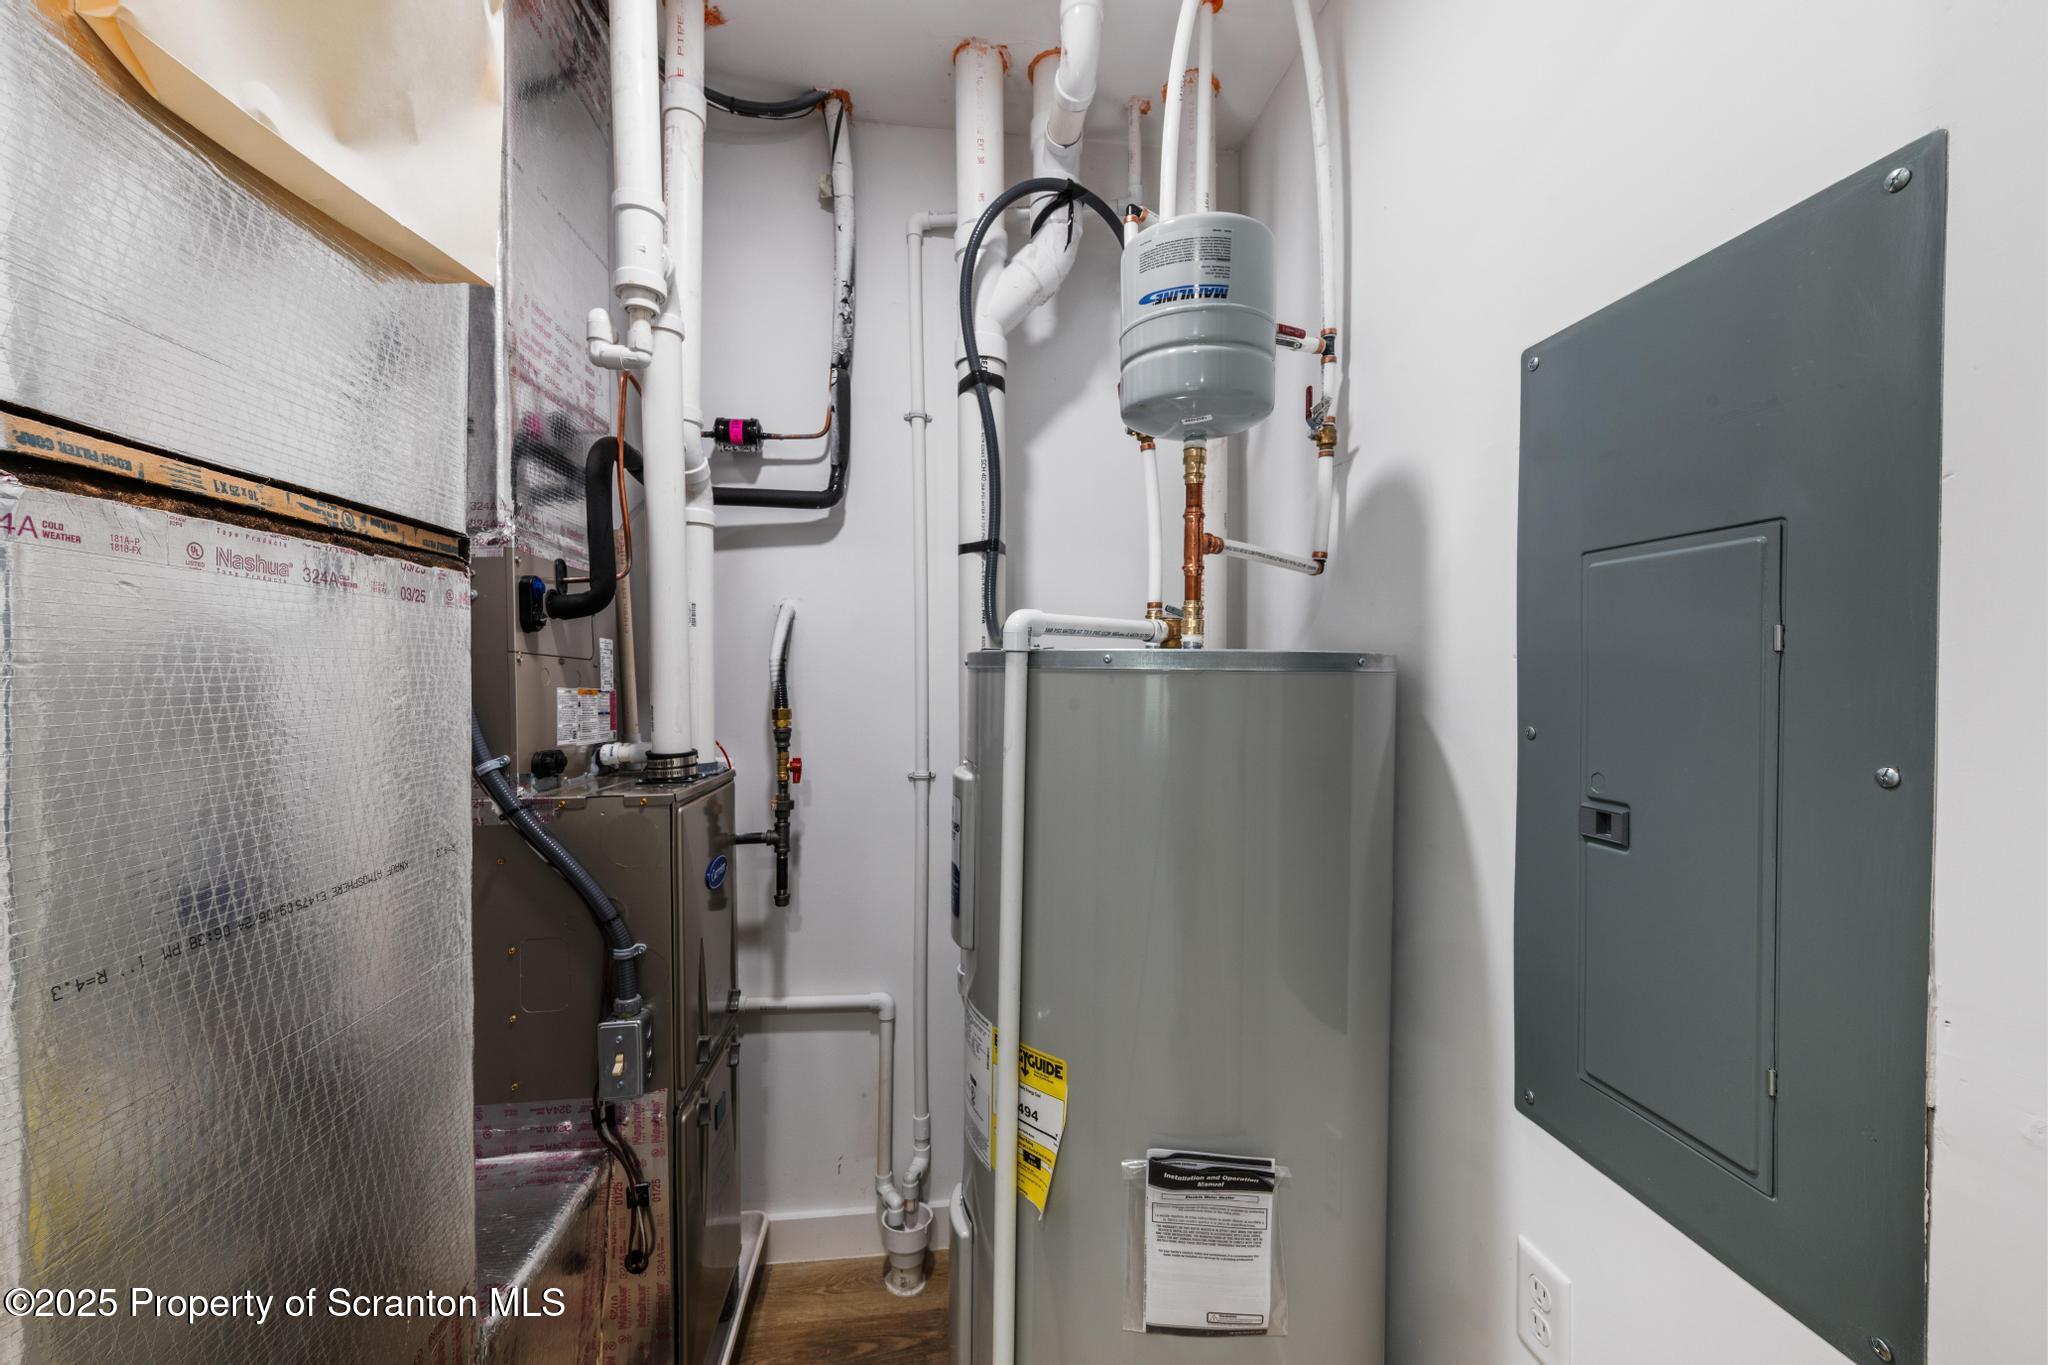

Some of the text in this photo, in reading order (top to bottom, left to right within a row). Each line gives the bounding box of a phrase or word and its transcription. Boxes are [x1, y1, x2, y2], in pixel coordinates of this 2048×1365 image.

[1153, 286, 1229, 306] MAINLINE
[12, 428, 133, 473] KOCH FILTER CORP.
[41, 519, 64, 532] COLD
[41, 530, 82, 544] WEATHER
[215, 546, 293, 578] Nashua
[302, 566, 339, 589] 324A
[400, 586, 426, 604] 03/25
[386, 860, 409, 878] KNAUF
[330, 869, 383, 898] ATMOSPHERE
[188, 924, 231, 950] 06:38
[161, 943, 182, 961] PM
[50, 969, 108, 1002] R=4.3
[1163, 1171, 1205, 1182] Installation
[1221, 1174, 1260, 1184] Operation
[651, 1178, 661, 1203] 01/25
[656, 1250, 666, 1277] 324A
